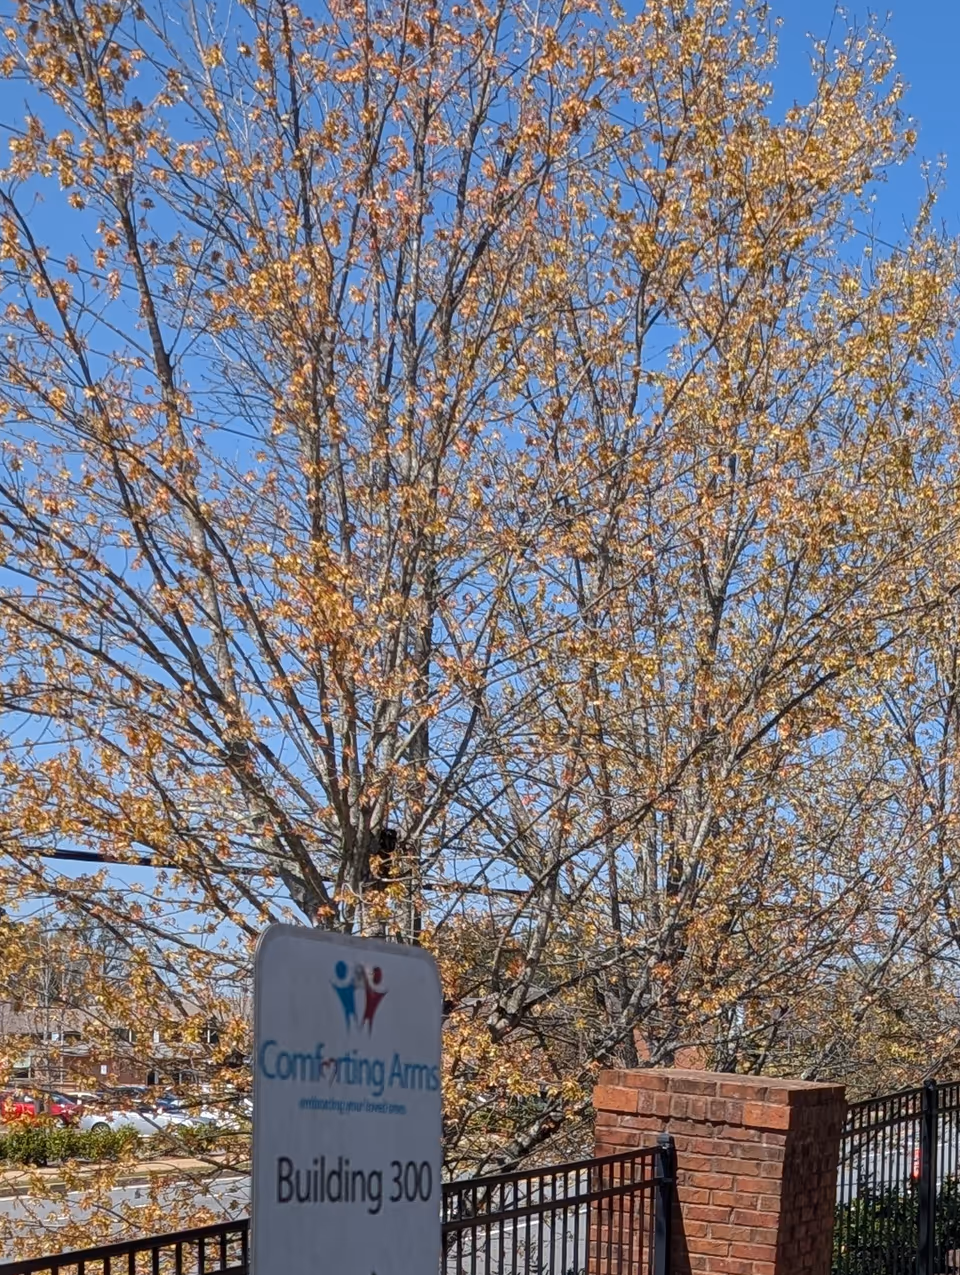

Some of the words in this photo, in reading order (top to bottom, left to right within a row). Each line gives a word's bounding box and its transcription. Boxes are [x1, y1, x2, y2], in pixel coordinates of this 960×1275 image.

[260, 1039, 385, 1097] Comforting
[388, 1052, 439, 1092] Arms
[277, 1155, 383, 1215] Building
[390, 1160, 433, 1202] 300
